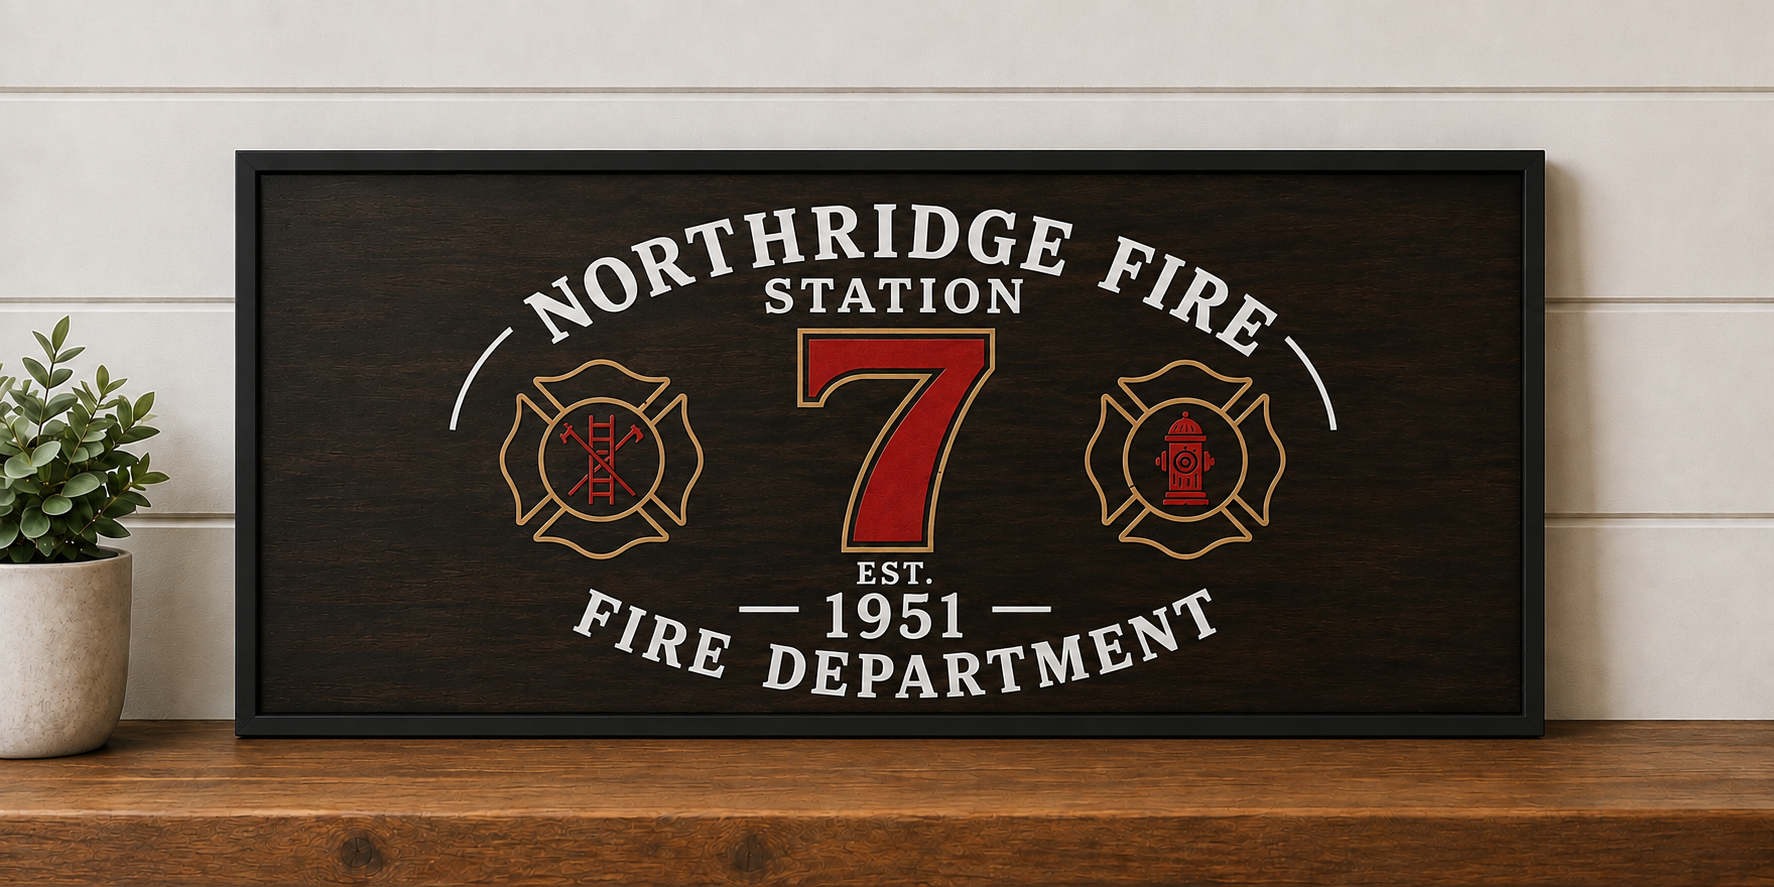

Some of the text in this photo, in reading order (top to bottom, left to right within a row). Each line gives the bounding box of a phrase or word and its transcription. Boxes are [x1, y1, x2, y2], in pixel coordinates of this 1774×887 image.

[523, 203, 1278, 358] NORTHRIDGE FIRE
[764, 277, 1024, 314] STATION
[797, 328, 995, 553] 7
[856, 561, 933, 585] EST.
[572, 588, 1217, 698] FIRE DEPARTMENT
[826, 591, 963, 640] 1951
